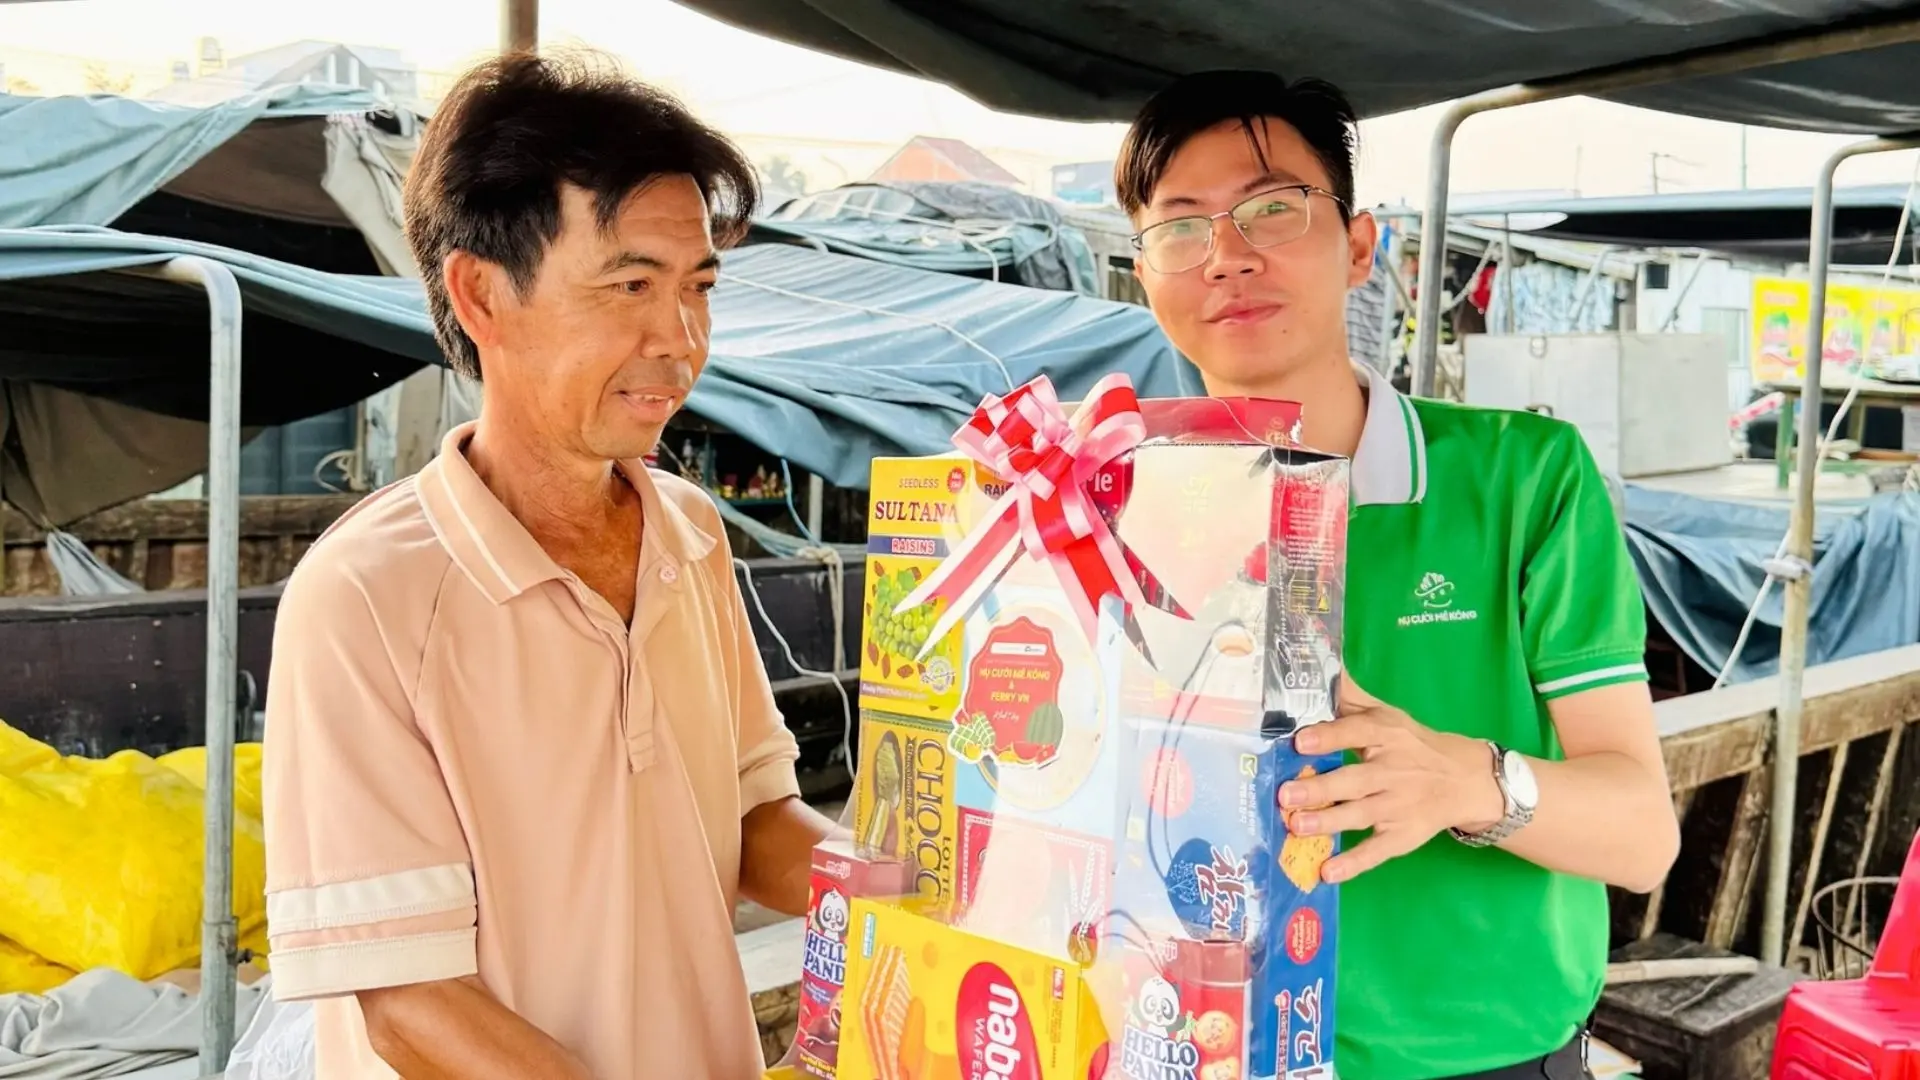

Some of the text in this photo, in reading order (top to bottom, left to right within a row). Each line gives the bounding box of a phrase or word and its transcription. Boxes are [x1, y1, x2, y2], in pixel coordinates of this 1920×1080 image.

[898, 477, 940, 489] SEEDLESS
[983, 483, 1008, 496] RAI
[875, 500, 960, 523] SULTANA
[891, 538, 936, 555] RAISINS
[808, 932, 847, 964] HELL
[804, 951, 846, 983] PAND
[1124, 1027, 1197, 1067] HELLO
